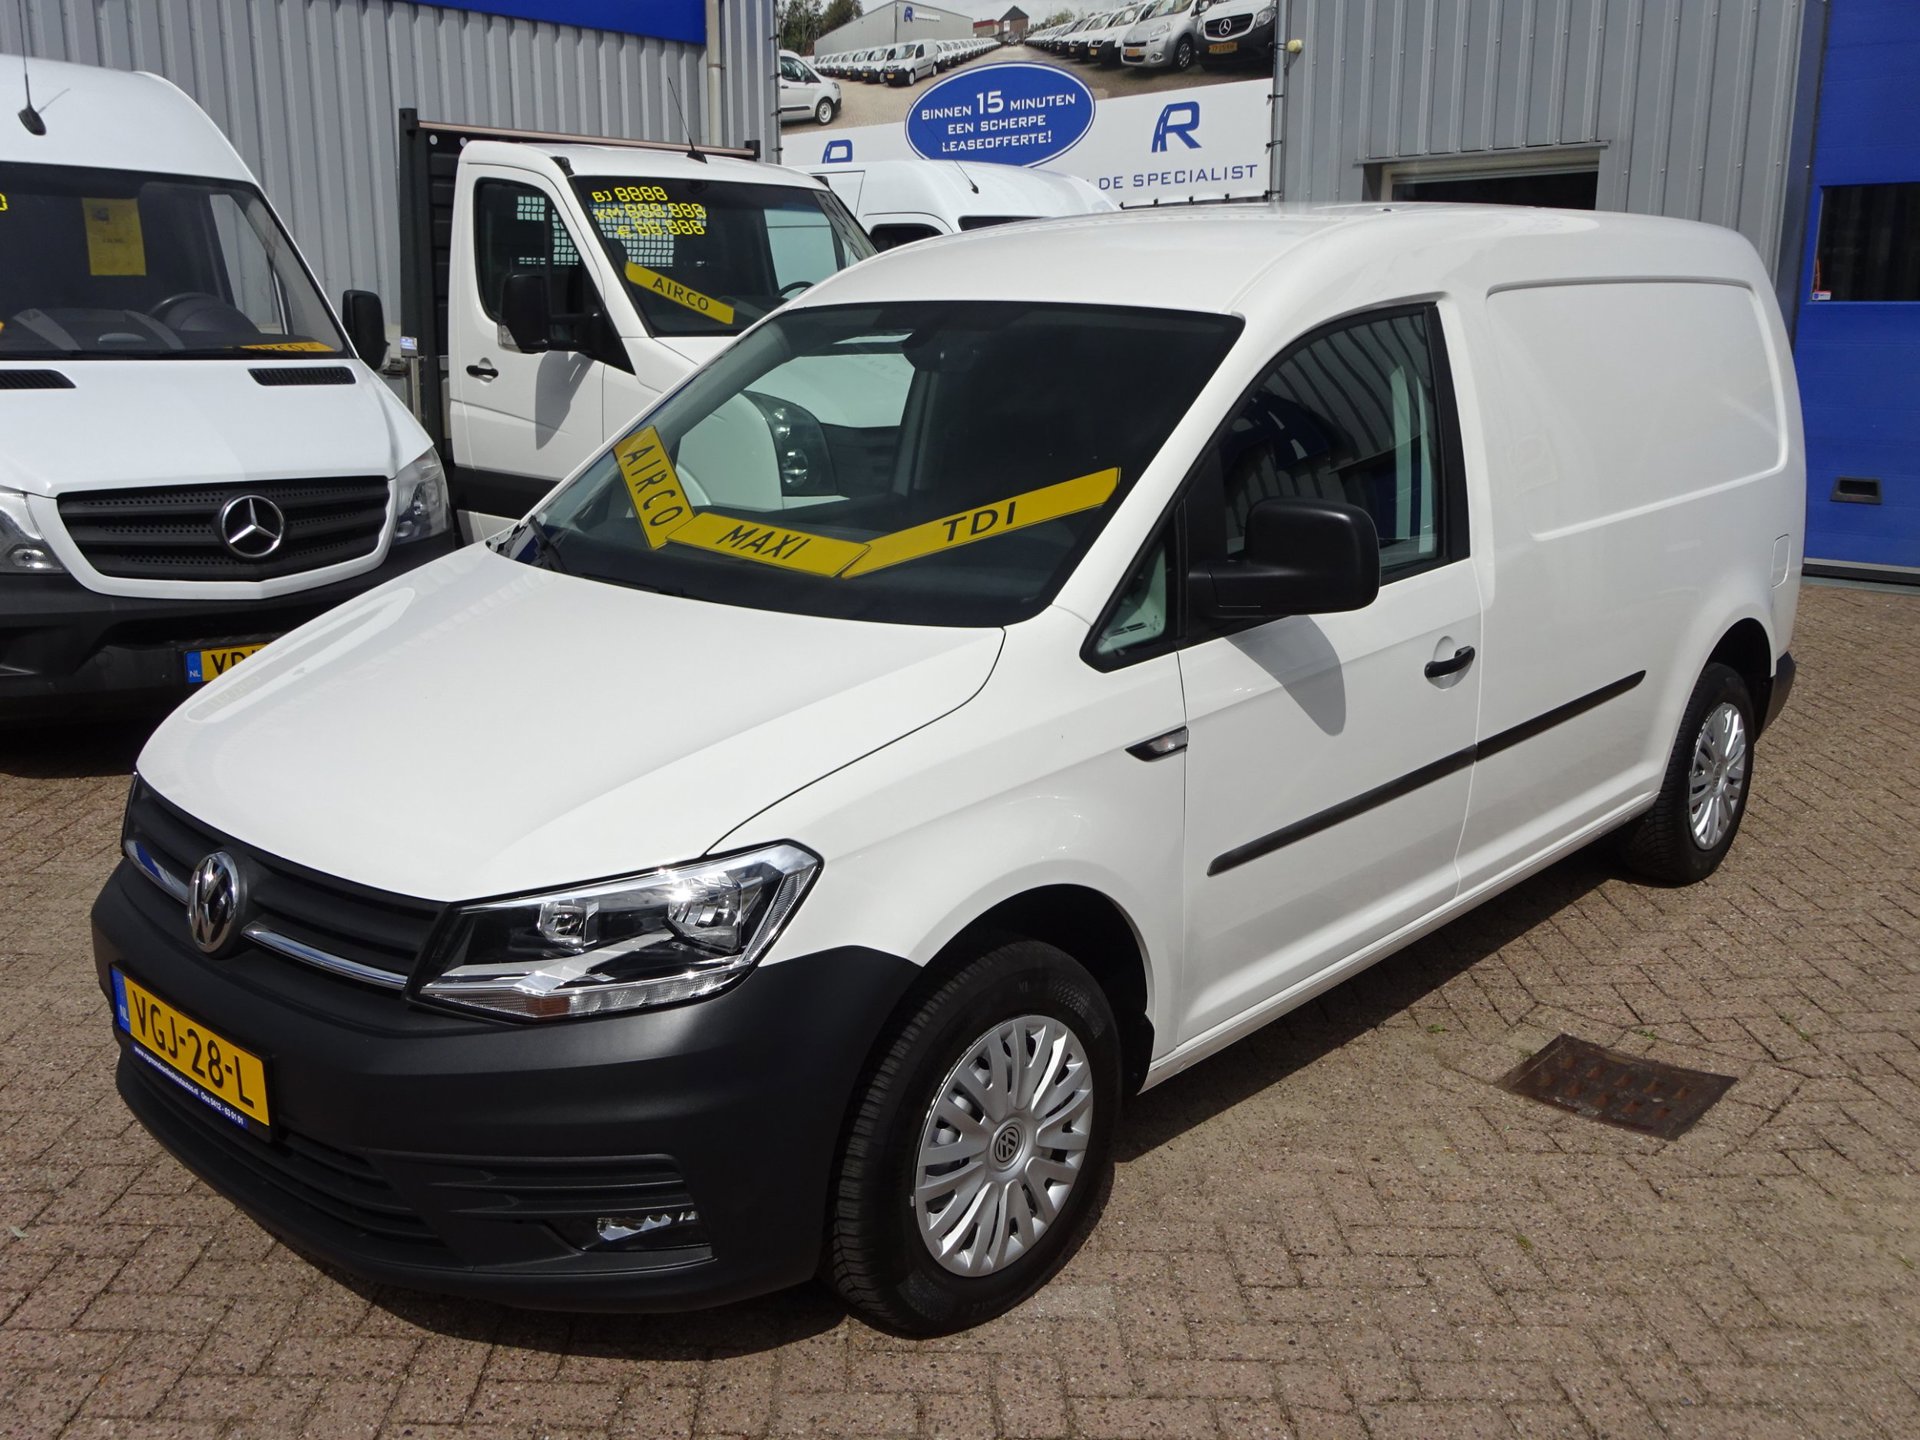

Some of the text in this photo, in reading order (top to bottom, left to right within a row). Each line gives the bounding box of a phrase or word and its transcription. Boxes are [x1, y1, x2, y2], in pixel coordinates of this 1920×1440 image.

[921, 90, 1076, 121] BINNEN 15 MINUTEN
[947, 114, 1046, 135] EEN SCHERPE
[942, 130, 1052, 152] LEASEOFFERTE!
[1099, 164, 1258, 190] DE SPECIALIST
[592, 186, 668, 203] BJ 8888
[596, 207, 623, 219] KM
[652, 276, 709, 311] AIRCO
[623, 445, 684, 527] AIRCO
[942, 500, 1016, 542] TDI
[715, 525, 812, 560] MAXI
[132, 990, 255, 1109] VGJ-28-L
